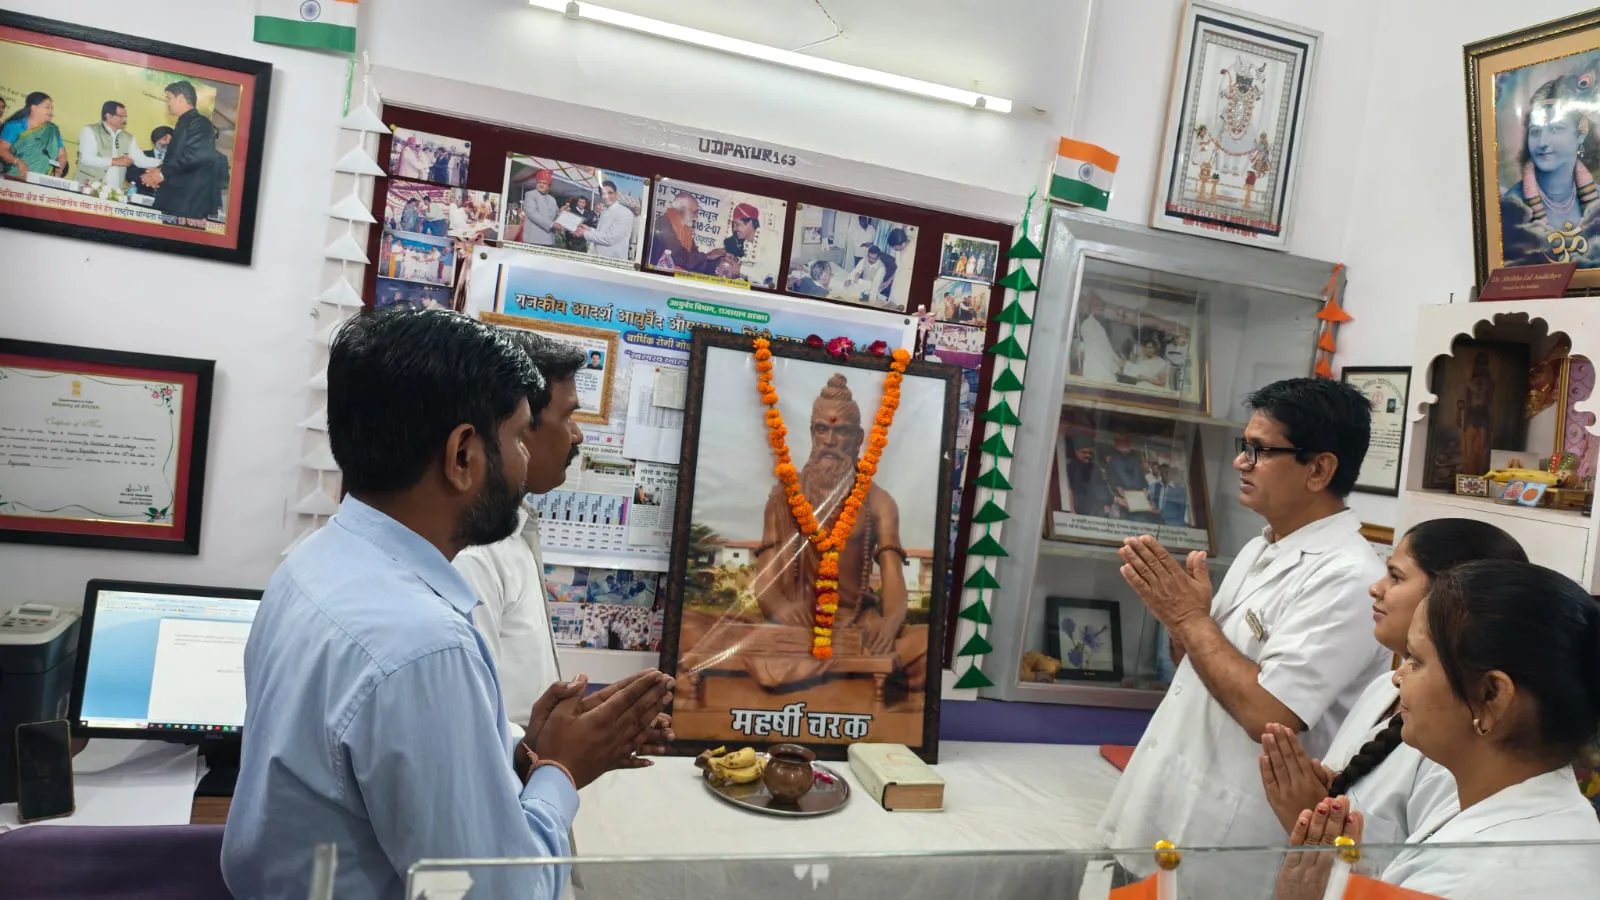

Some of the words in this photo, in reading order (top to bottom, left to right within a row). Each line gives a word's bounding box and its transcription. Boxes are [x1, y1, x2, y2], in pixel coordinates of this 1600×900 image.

[516, 292, 568, 315] राजकीय
[571, 303, 613, 323] आदर्श
[617, 308, 664, 331] आयुर्वेद
[730, 702, 806, 737] महर्षी
[807, 711, 873, 739] चरक
